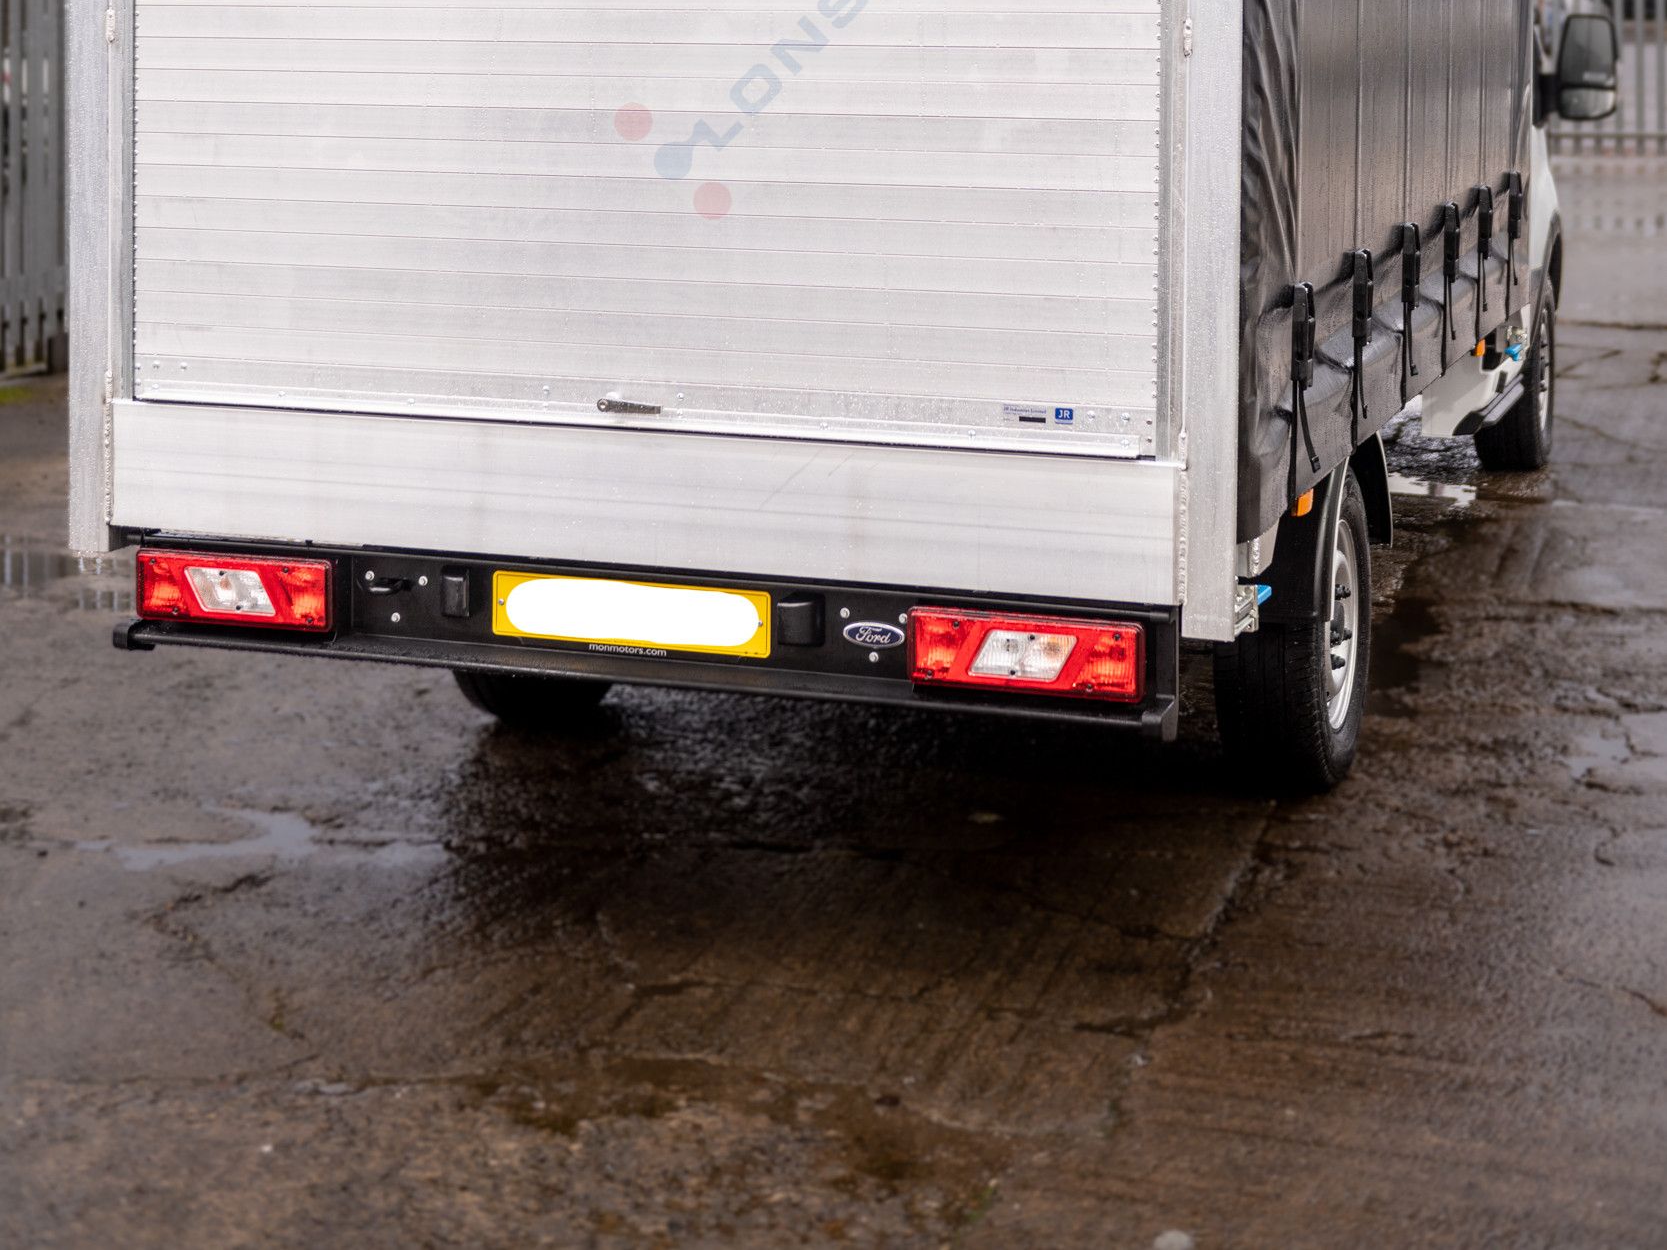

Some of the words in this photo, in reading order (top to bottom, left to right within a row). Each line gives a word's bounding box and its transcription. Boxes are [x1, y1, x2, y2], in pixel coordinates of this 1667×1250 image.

[1058, 410, 1071, 419] JR
[855, 626, 892, 644] Ford
[588, 643, 667, 657] monmotors.com
